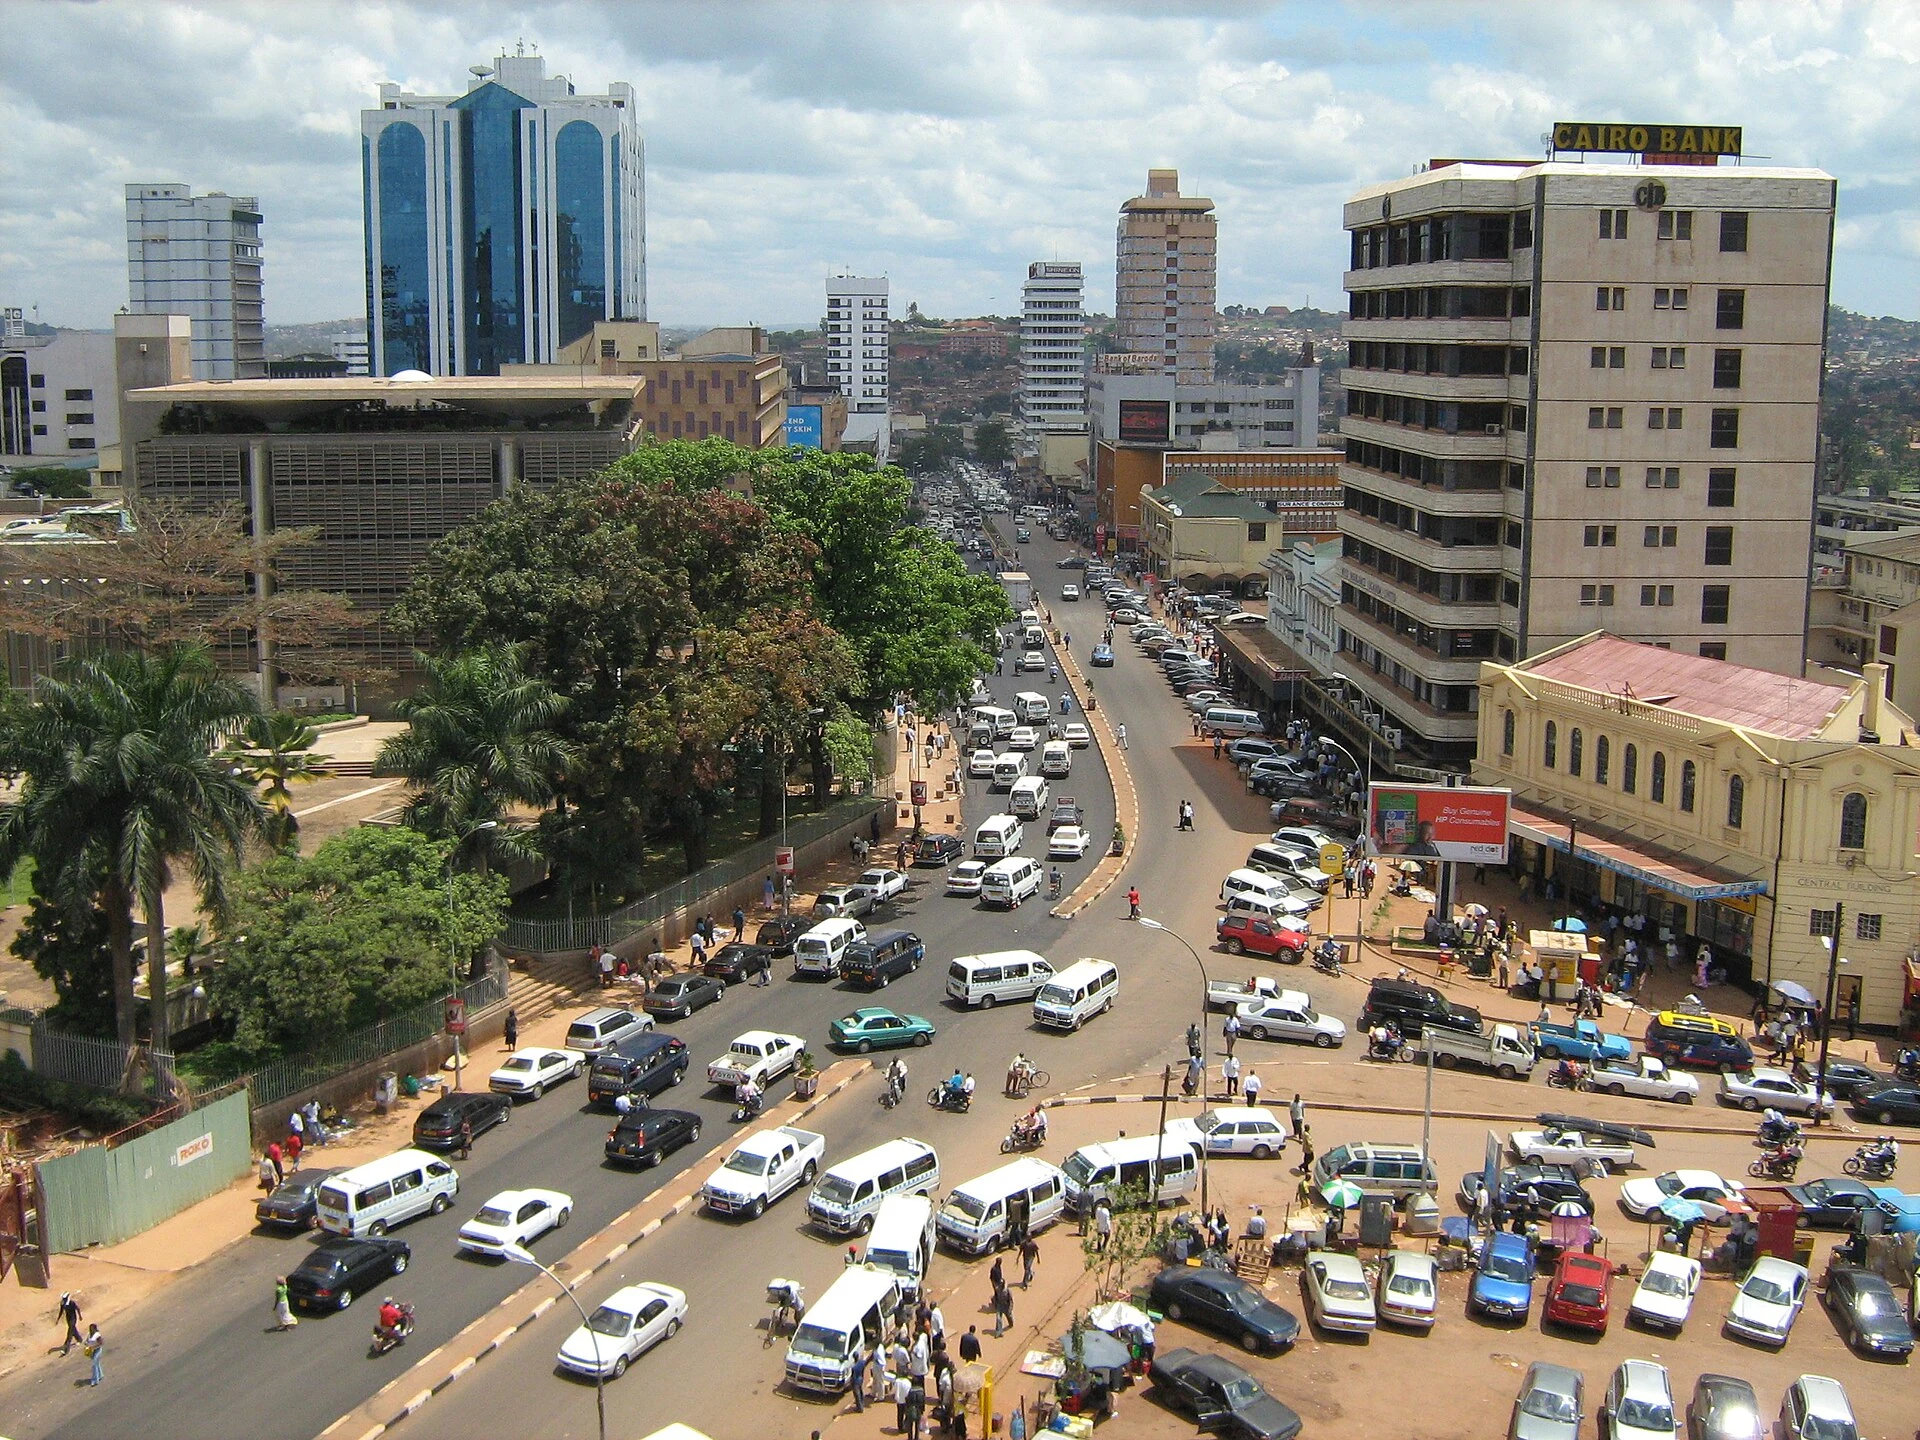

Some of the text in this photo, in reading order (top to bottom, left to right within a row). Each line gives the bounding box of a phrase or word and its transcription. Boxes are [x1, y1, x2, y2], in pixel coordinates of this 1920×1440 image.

[1554, 125, 1740, 153] CAIRO BANK
[1798, 878, 1892, 893] CENTRAL BUILDING
[180, 1138, 210, 1161] ROKO
